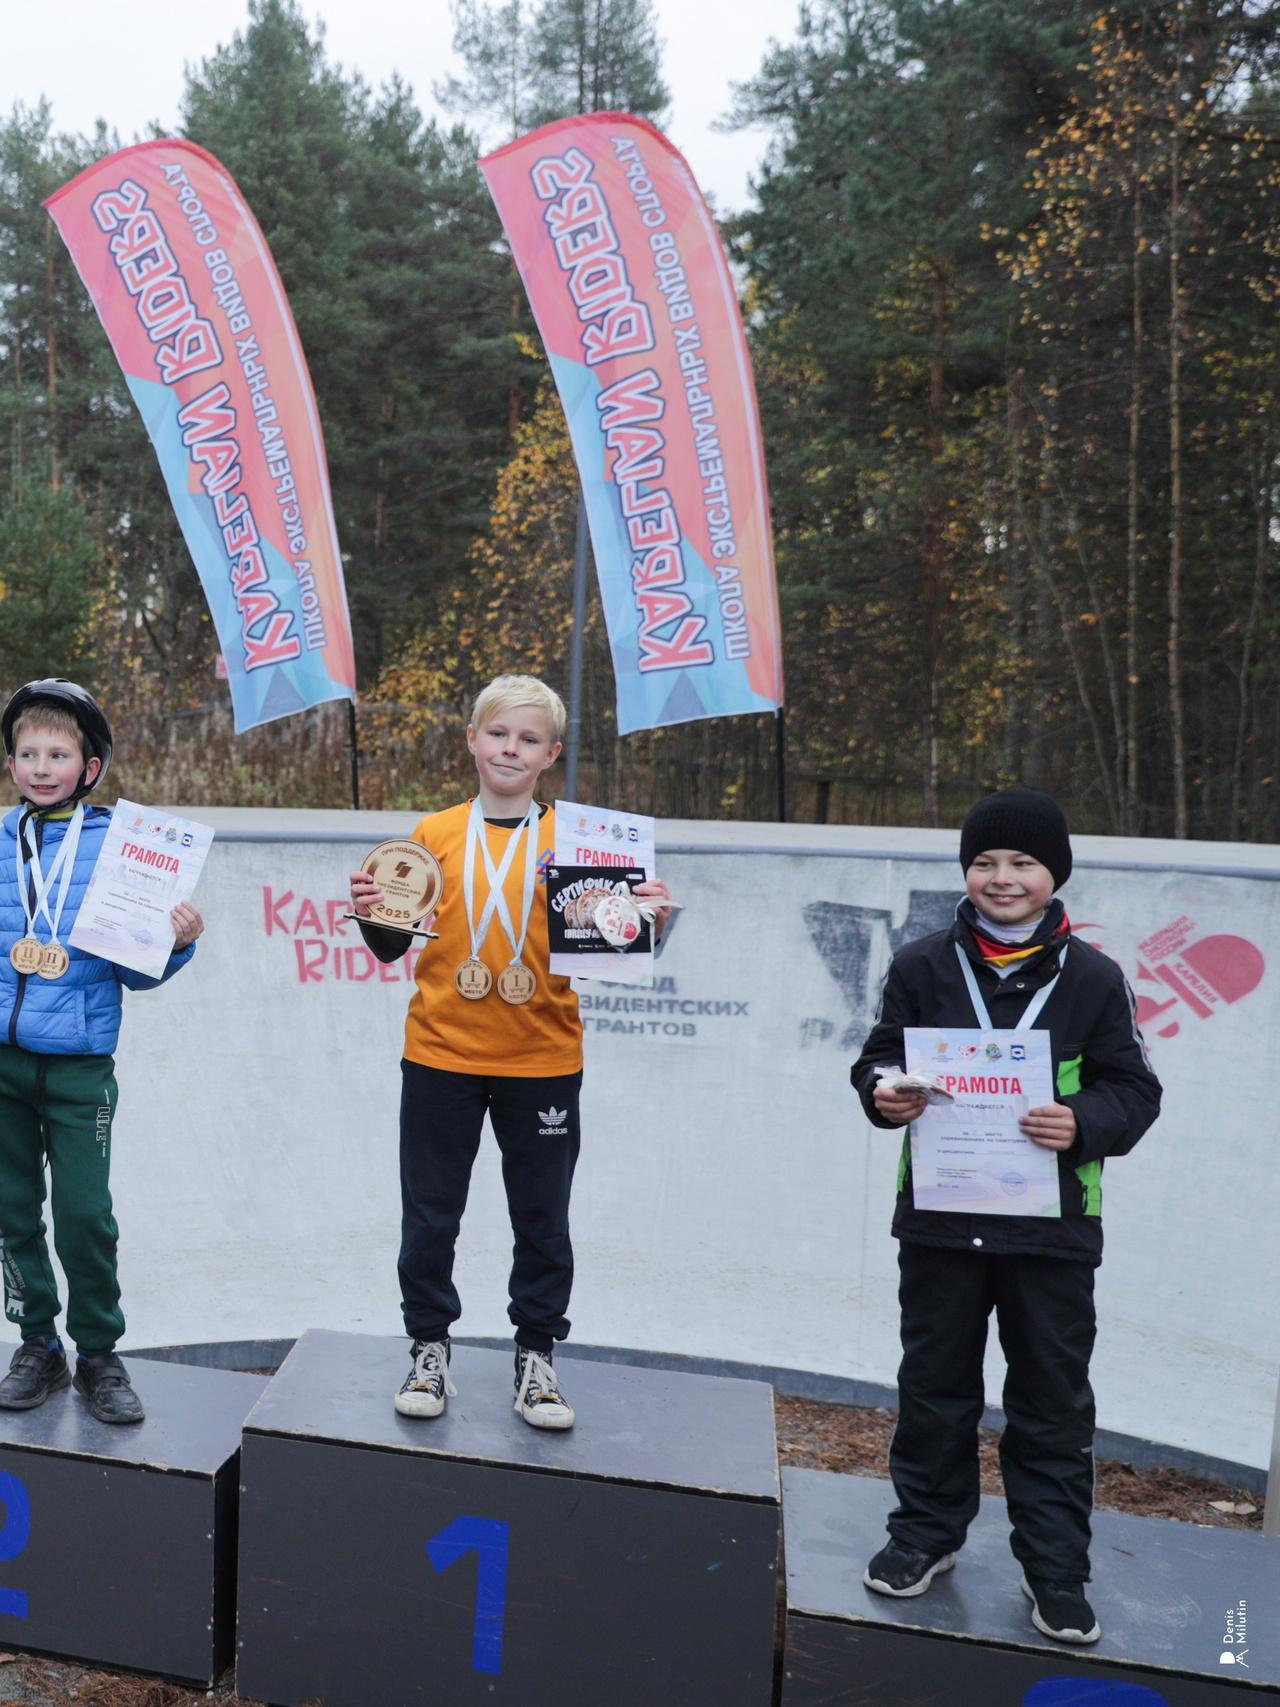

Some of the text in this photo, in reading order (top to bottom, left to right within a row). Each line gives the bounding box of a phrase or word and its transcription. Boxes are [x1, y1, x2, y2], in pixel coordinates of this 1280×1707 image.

[120, 842, 180, 874] ГРАМОТА
[381, 846, 430, 866] ПРИ ПОДДЕРЖКЕ
[576, 847, 635, 868] ГРАМОТА
[390, 879, 410, 888] ФОНДА
[551, 877, 624, 913] СЕРТИФИКА
[377, 904, 411, 919] 2025
[582, 1016, 698, 1038] ГРАНТОВ
[538, 1127, 568, 1135] adidas
[424, 1513, 511, 1676] 1
